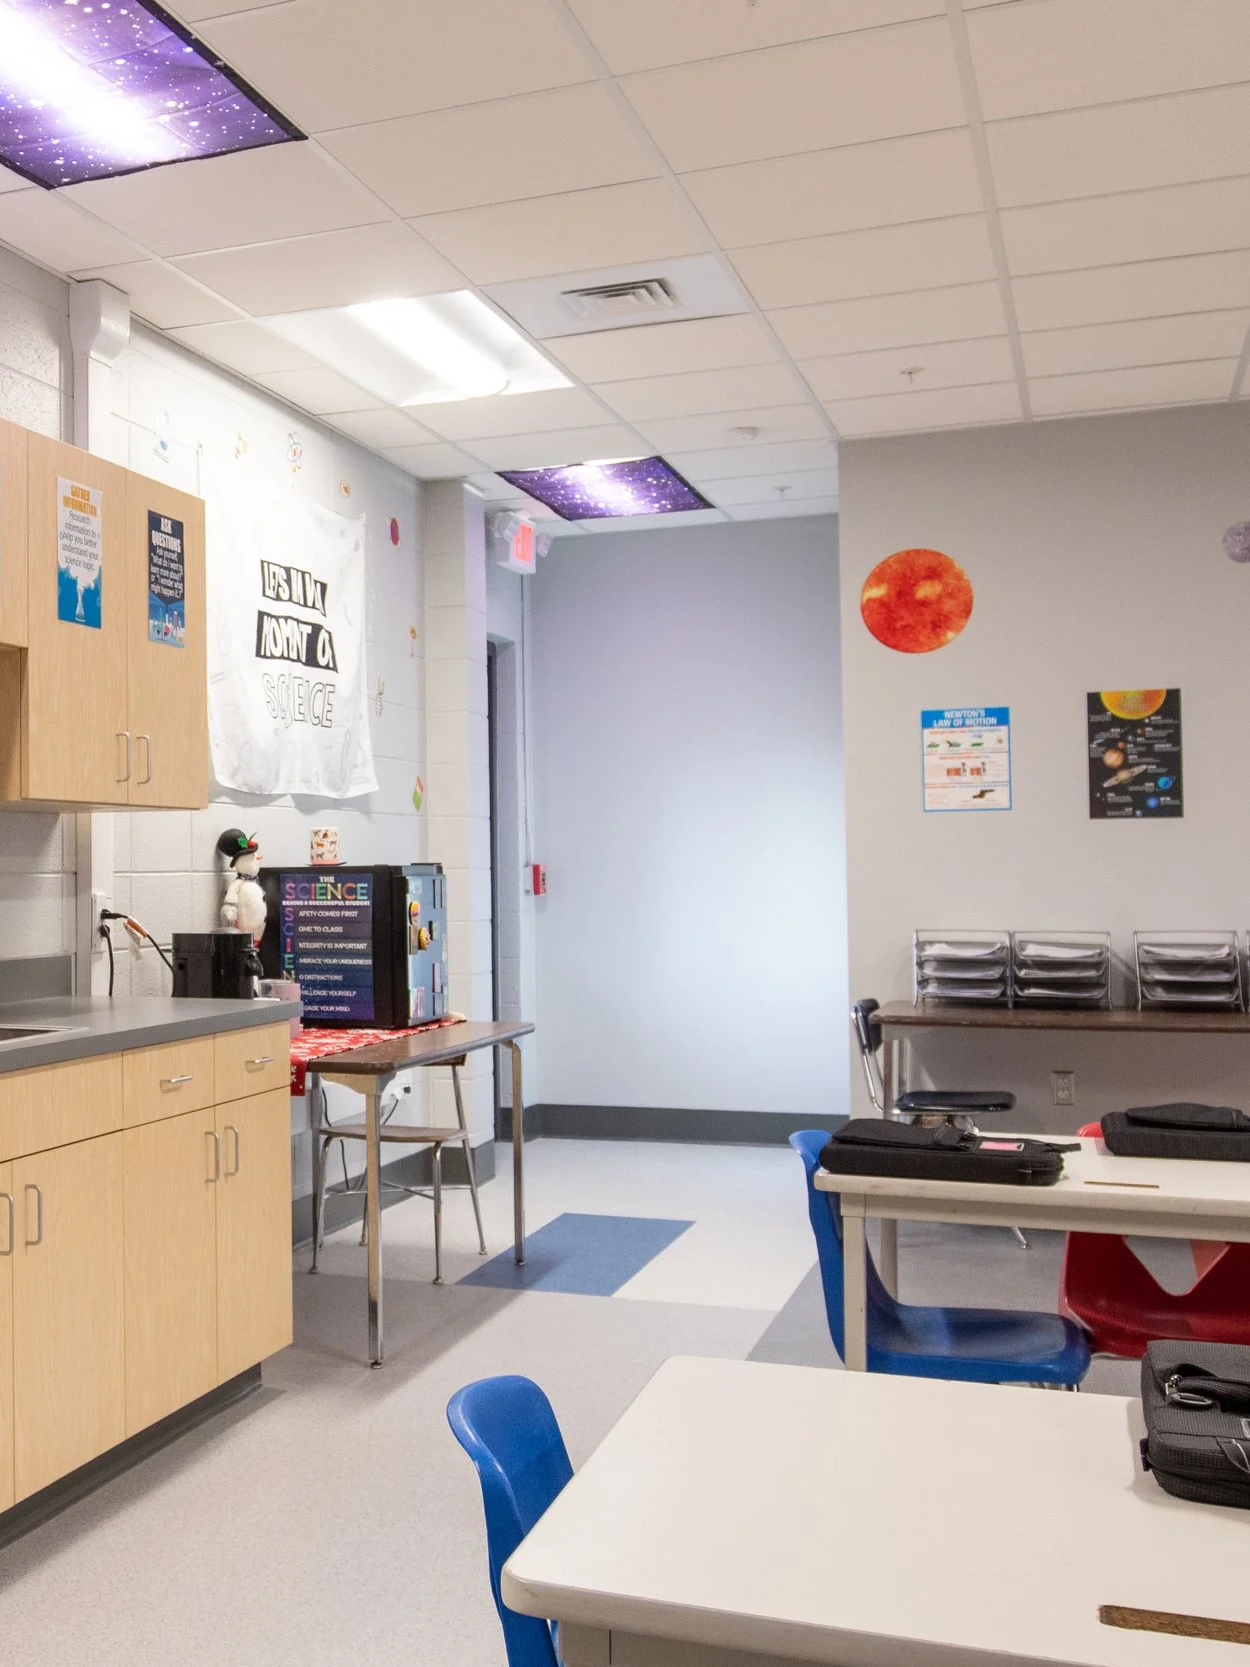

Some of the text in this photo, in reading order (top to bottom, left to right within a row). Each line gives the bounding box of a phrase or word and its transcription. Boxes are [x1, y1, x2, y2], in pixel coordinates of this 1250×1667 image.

[944, 709, 986, 719] NEWTON'S
[933, 717, 998, 727] LAW OF MOTION
[285, 882, 369, 900] SCIENCE
[317, 910, 340, 918] COMES
[341, 910, 359, 918] FIRST
